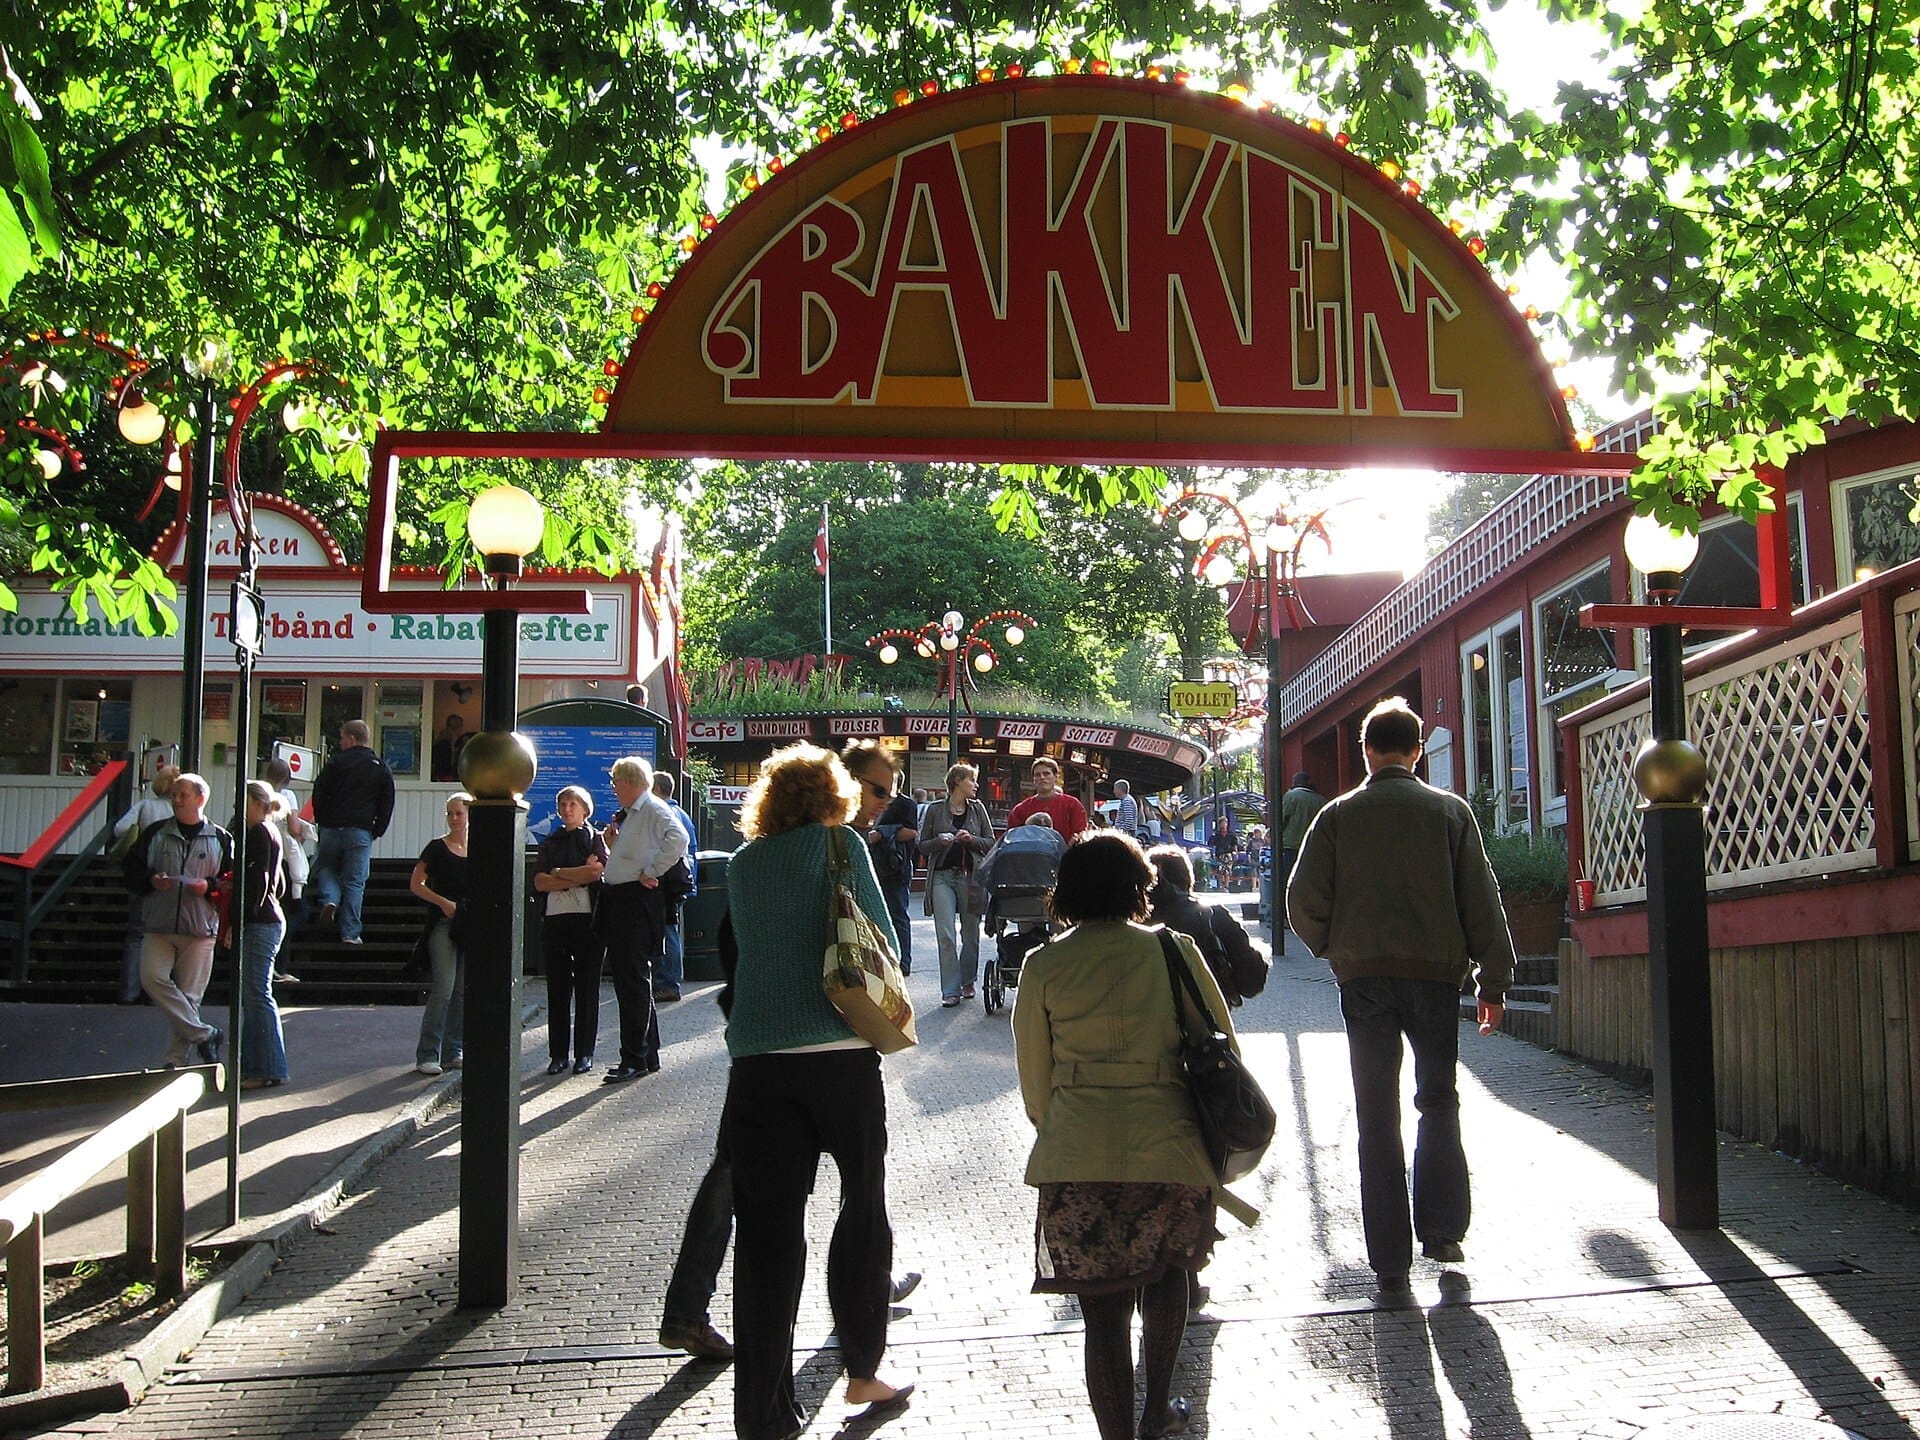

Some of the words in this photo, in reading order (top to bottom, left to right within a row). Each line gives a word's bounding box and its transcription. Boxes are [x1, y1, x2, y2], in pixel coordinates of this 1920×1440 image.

[701, 114, 1463, 418] BAKKEN
[210, 529, 298, 557] akken
[209, 611, 353, 639] Tbånd
[390, 613, 609, 642] Rabatæfter
[1174, 692, 1231, 707] TOILET
[691, 721, 738, 740] Café
[750, 721, 806, 736] SANDWICH
[834, 719, 880, 733] PØLSER
[910, 718, 972, 733] ISVAFER
[1002, 723, 1041, 737] FADØL
[1066, 727, 1094, 743] SOFT
[1094, 730, 1114, 744] ICE
